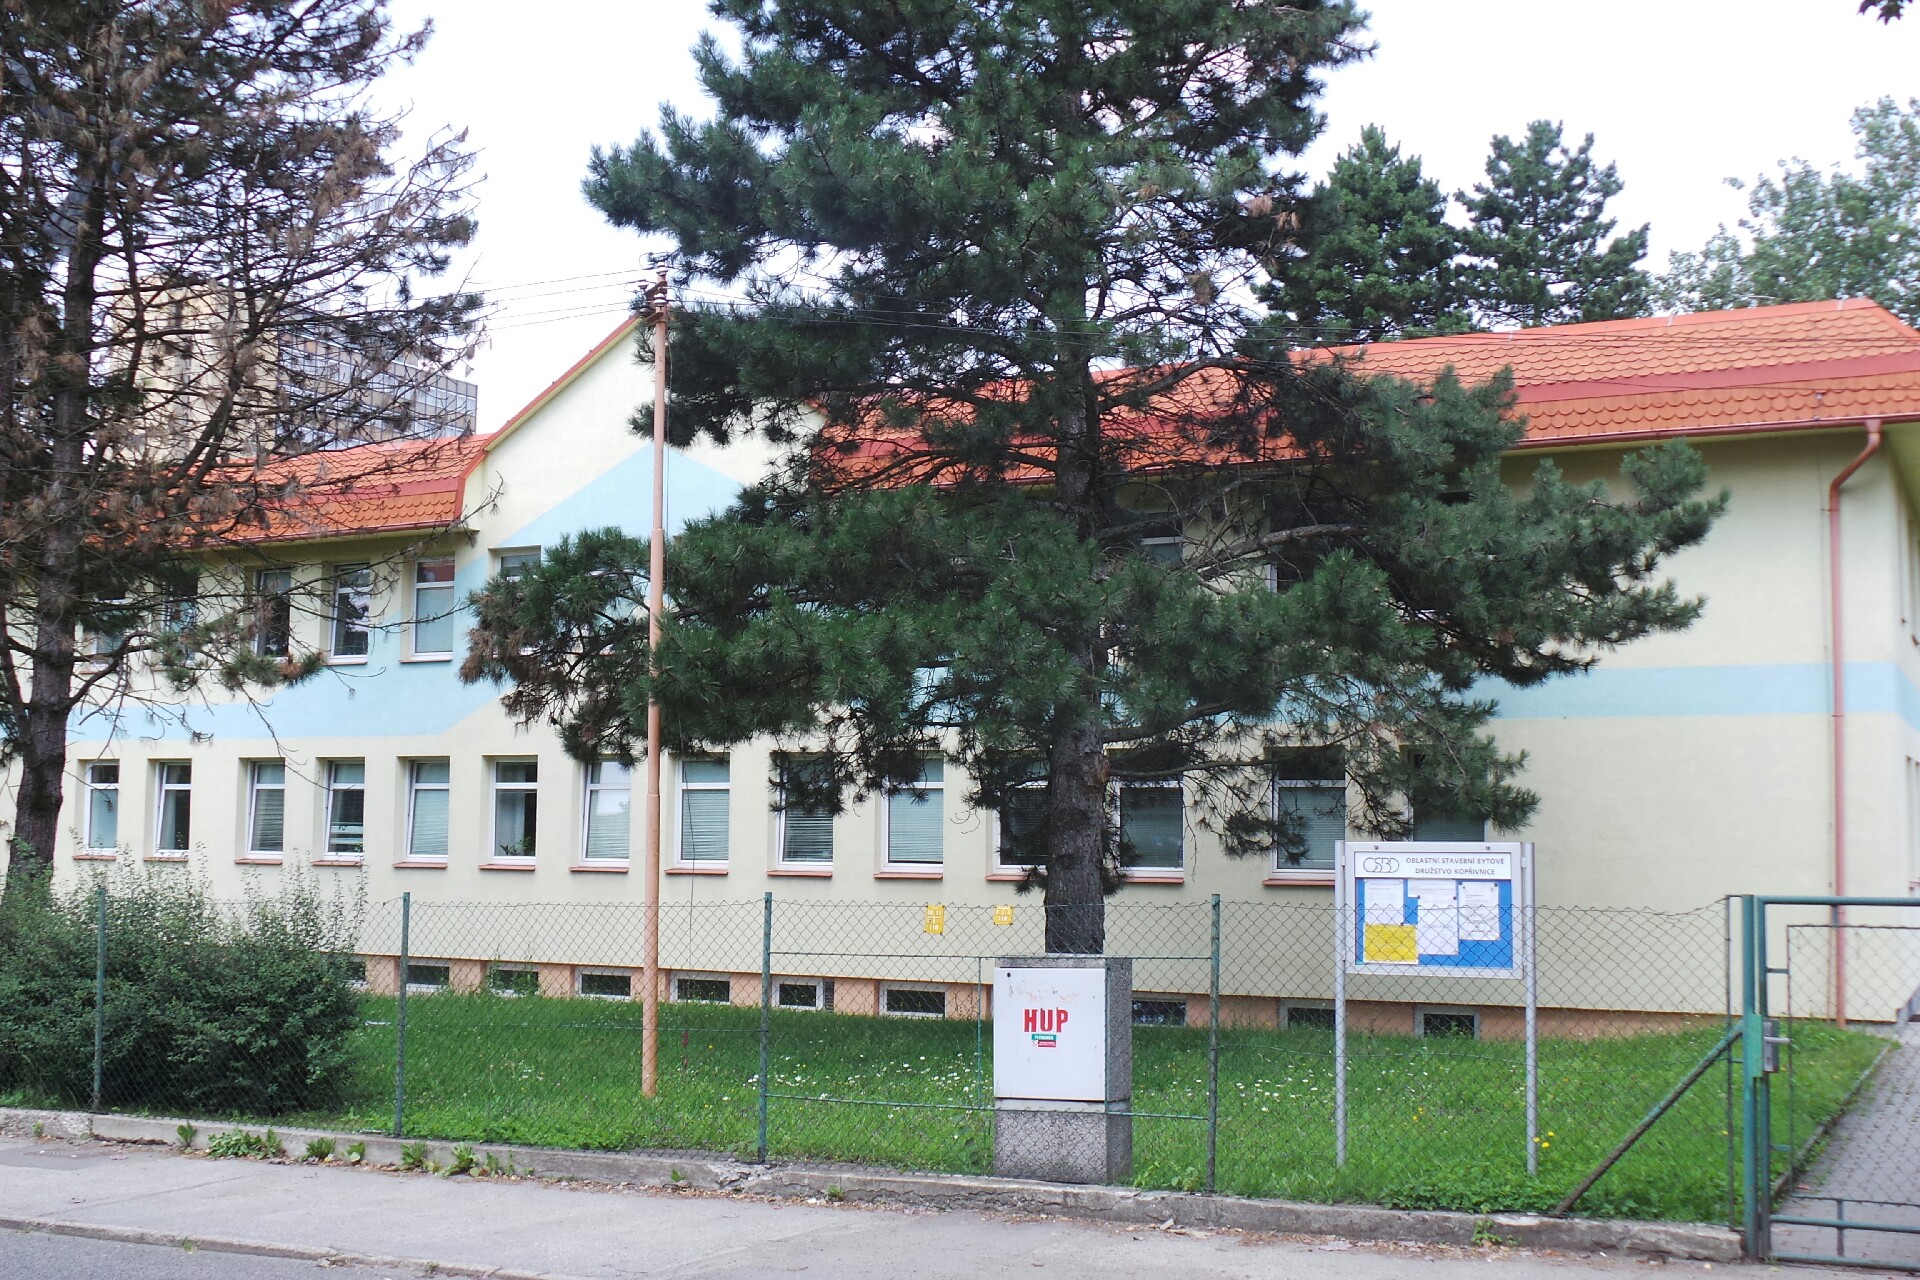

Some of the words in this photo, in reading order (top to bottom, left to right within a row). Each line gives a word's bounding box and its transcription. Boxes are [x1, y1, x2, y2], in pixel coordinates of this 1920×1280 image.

[1415, 867, 1452, 875] DRUŽSTVO
[1454, 867, 1496, 876] KOPŘIVNICE
[1024, 1007, 1069, 1033] HUP
